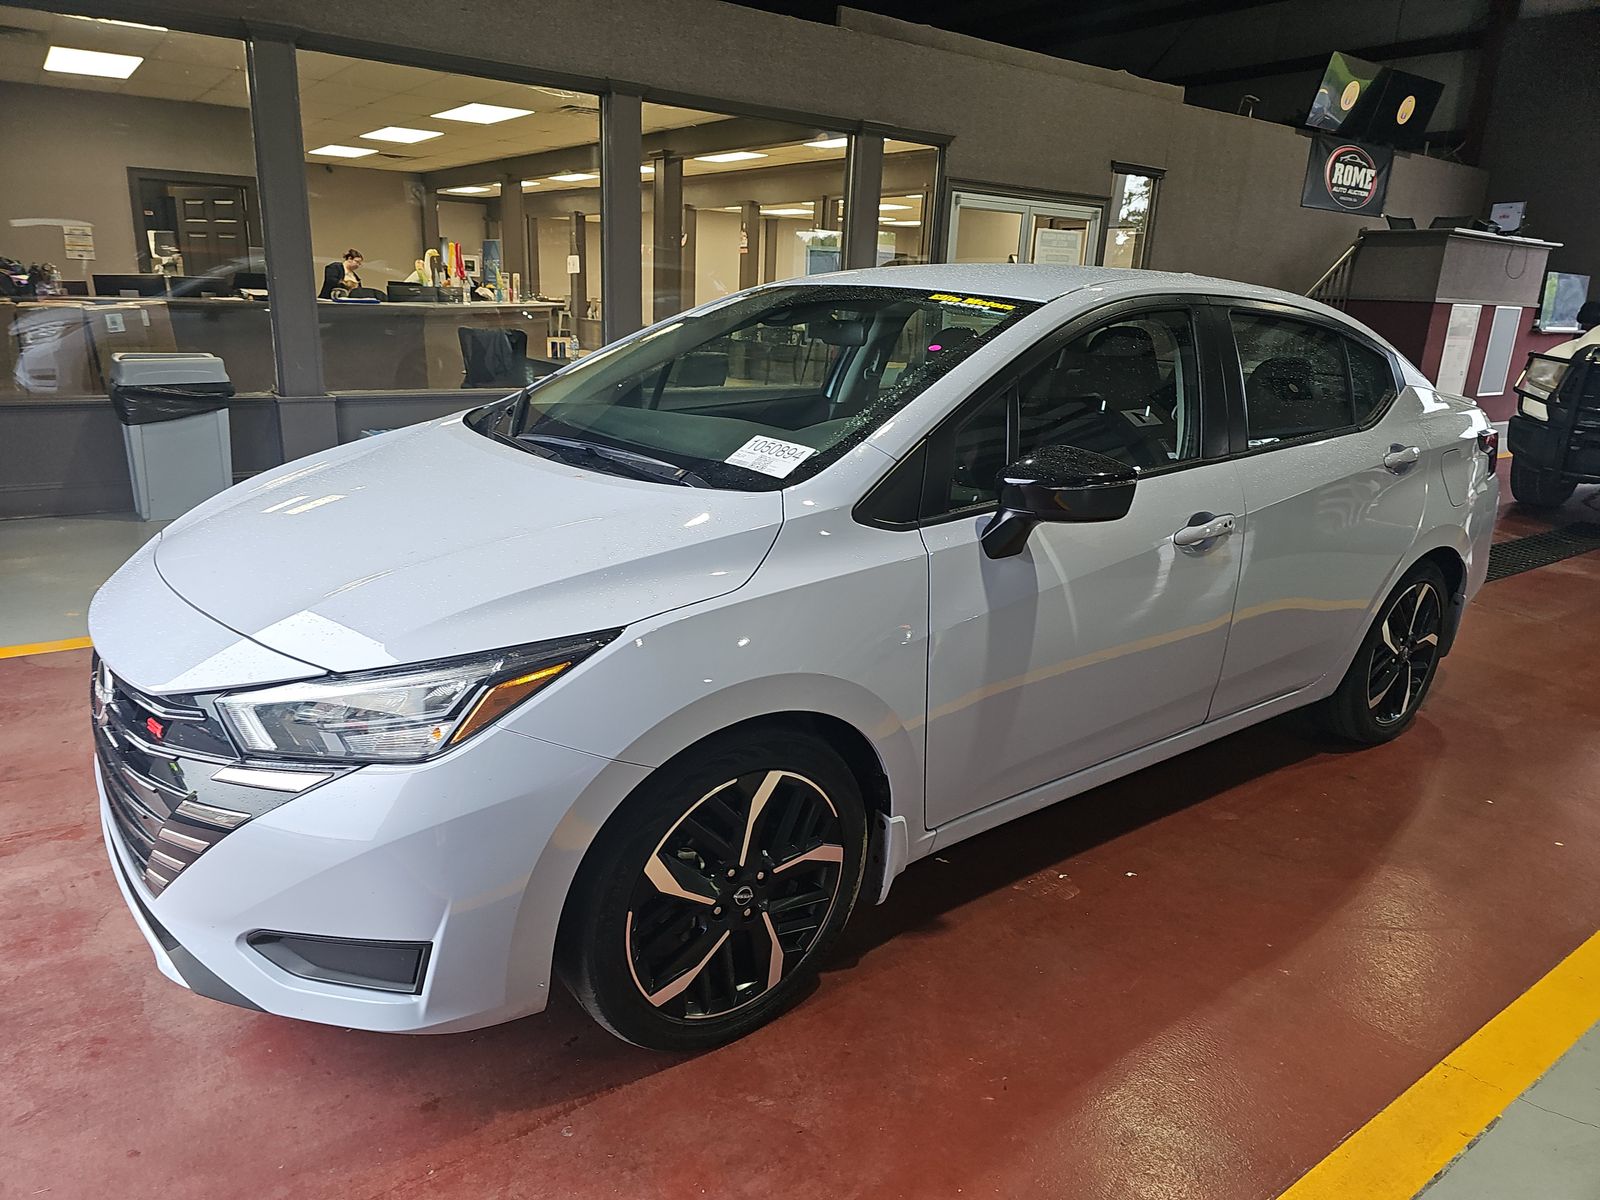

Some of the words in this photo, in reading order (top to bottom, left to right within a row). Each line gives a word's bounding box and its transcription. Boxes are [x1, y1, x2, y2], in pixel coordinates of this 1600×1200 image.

[1332, 162, 1376, 189] ROME
[962, 298, 1016, 310] Motors
[747, 439, 806, 462] 1050894
